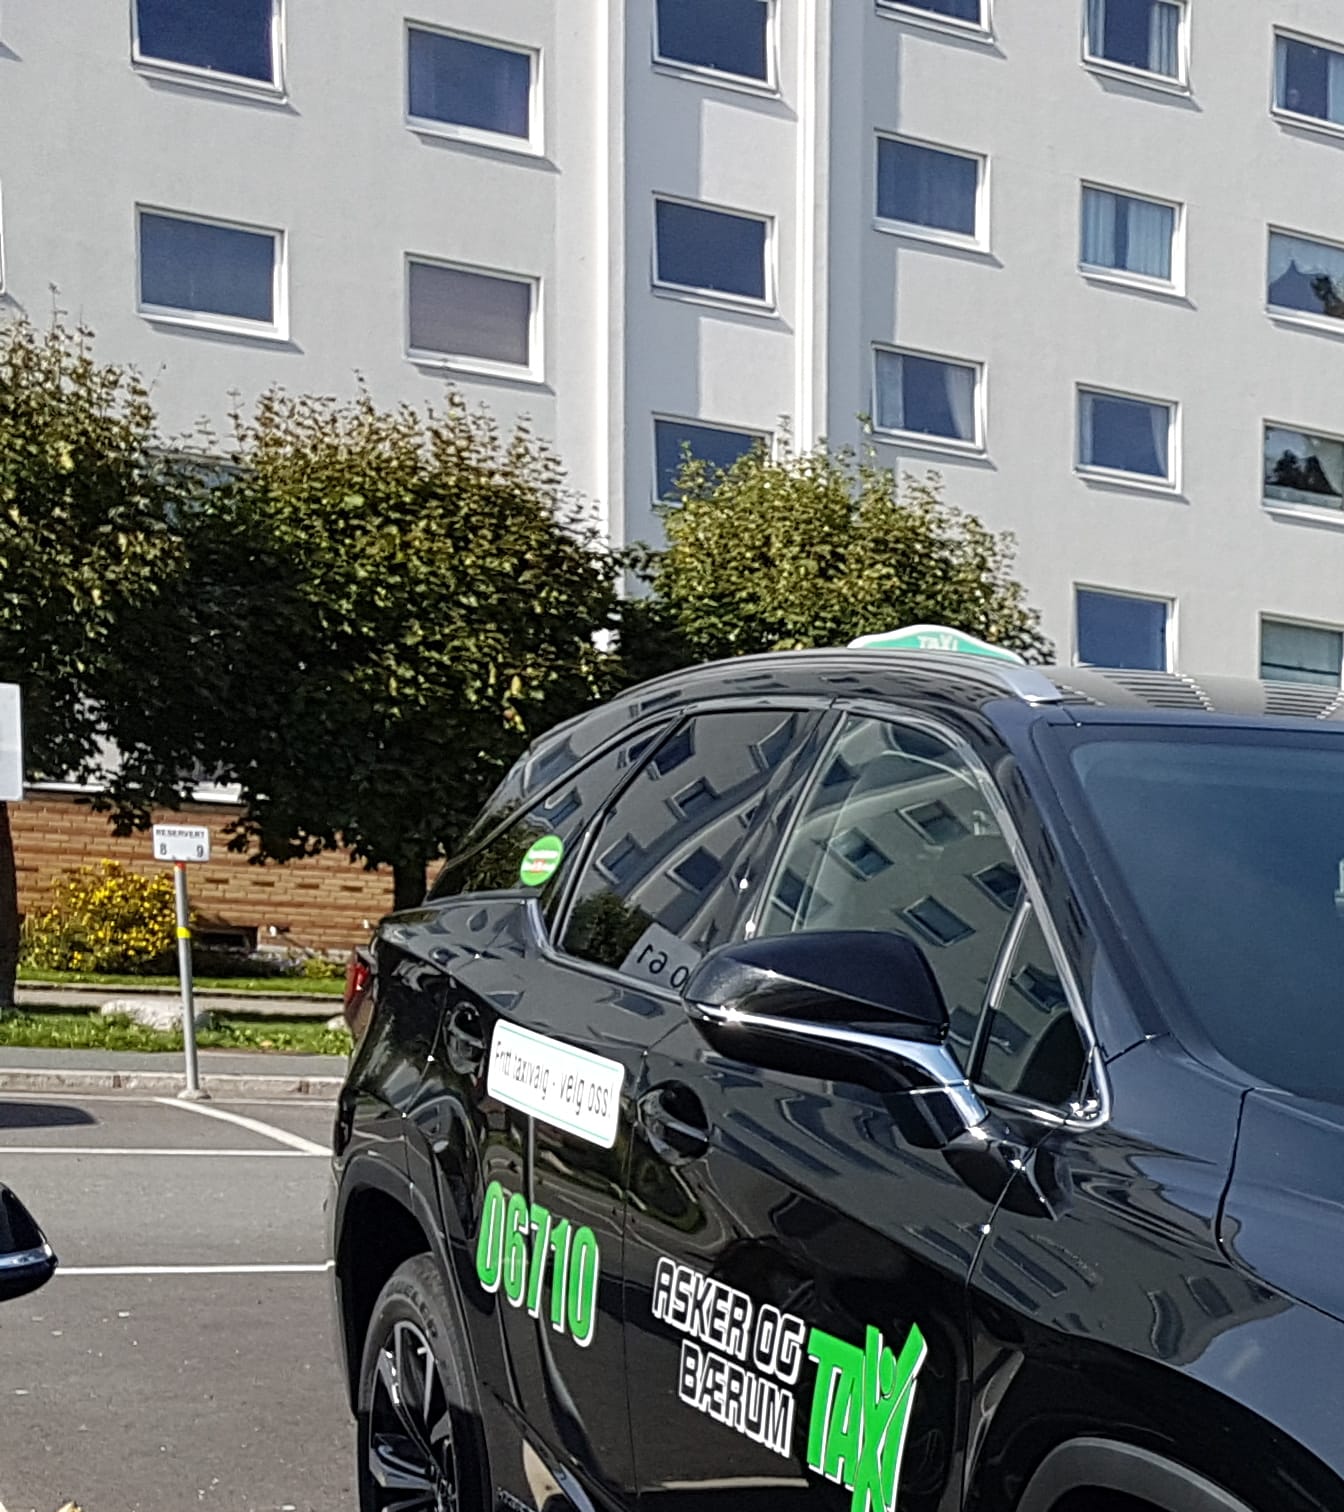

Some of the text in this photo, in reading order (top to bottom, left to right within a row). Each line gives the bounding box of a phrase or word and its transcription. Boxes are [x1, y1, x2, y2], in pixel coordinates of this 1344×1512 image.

[559, 1071, 585, 1116] velg
[476, 1181, 598, 1347] 06710
[652, 1257, 806, 1384] ASKER OG
[679, 1340, 795, 1458] BÆRUM
